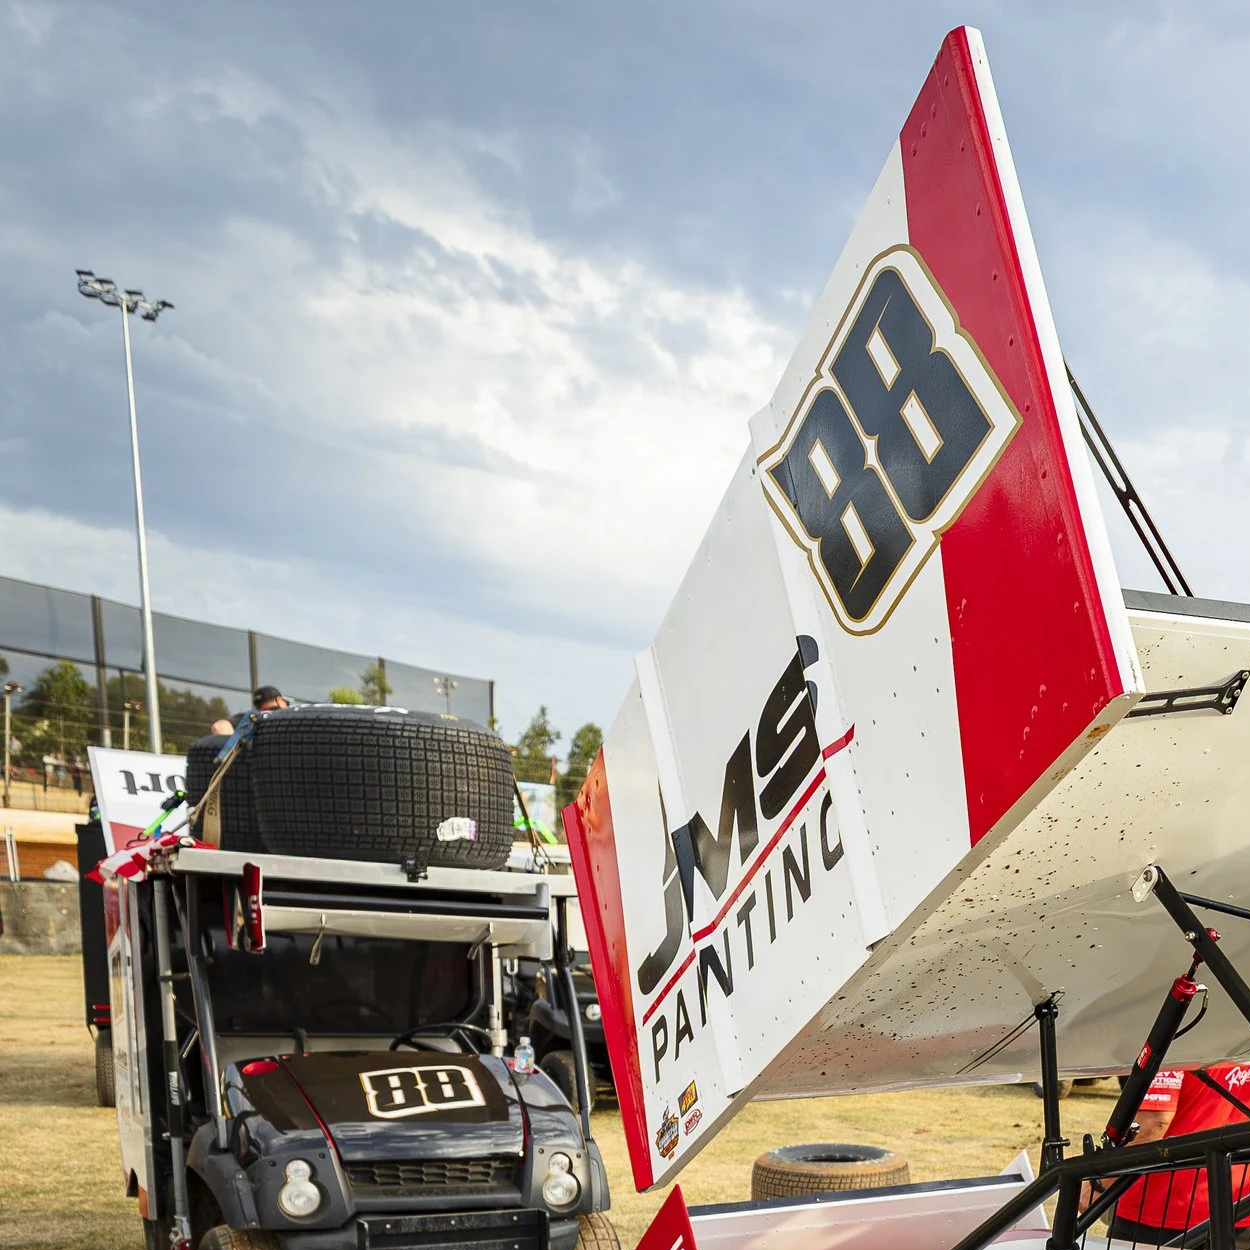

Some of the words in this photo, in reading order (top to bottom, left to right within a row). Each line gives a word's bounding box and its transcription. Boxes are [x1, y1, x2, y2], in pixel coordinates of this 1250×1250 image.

[766, 266, 995, 622] 88
[638, 635, 821, 996] JMS
[362, 1066, 486, 1117] 88
